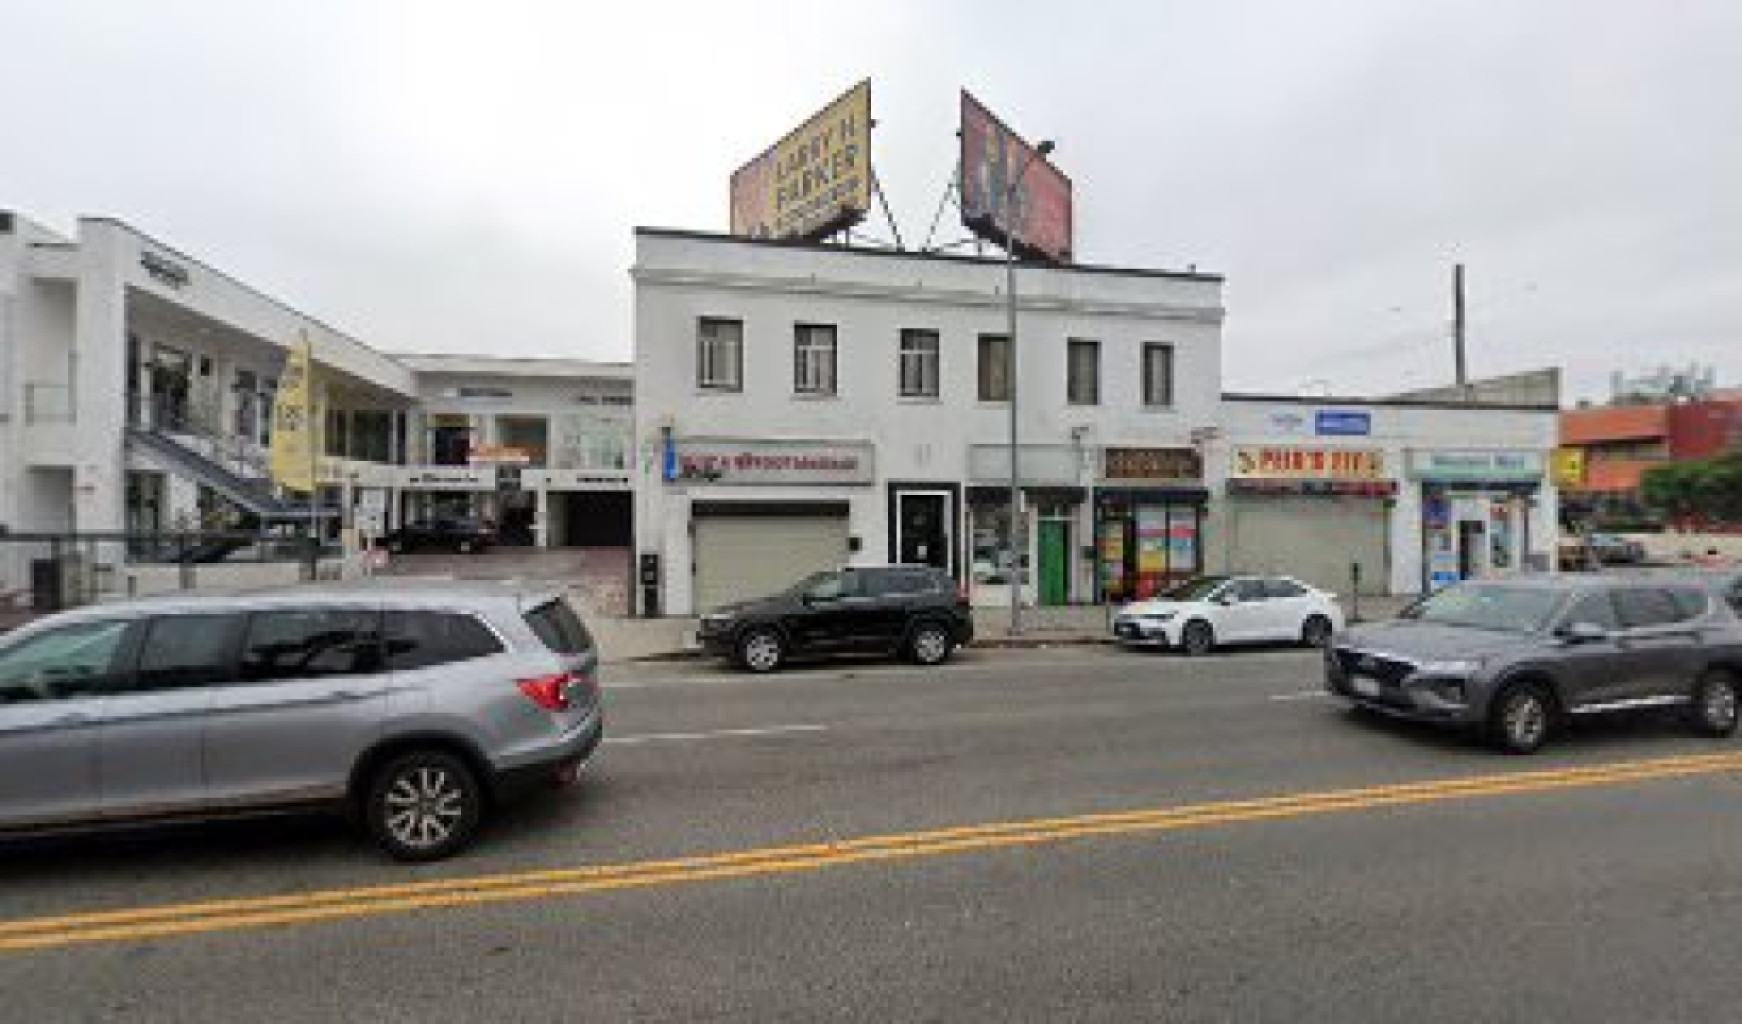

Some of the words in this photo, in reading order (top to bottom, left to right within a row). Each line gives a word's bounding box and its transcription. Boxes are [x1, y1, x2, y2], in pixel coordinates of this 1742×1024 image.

[776, 128, 833, 184] LARRY
[840, 114, 855, 145] H
[776, 144, 861, 213] PARKER
